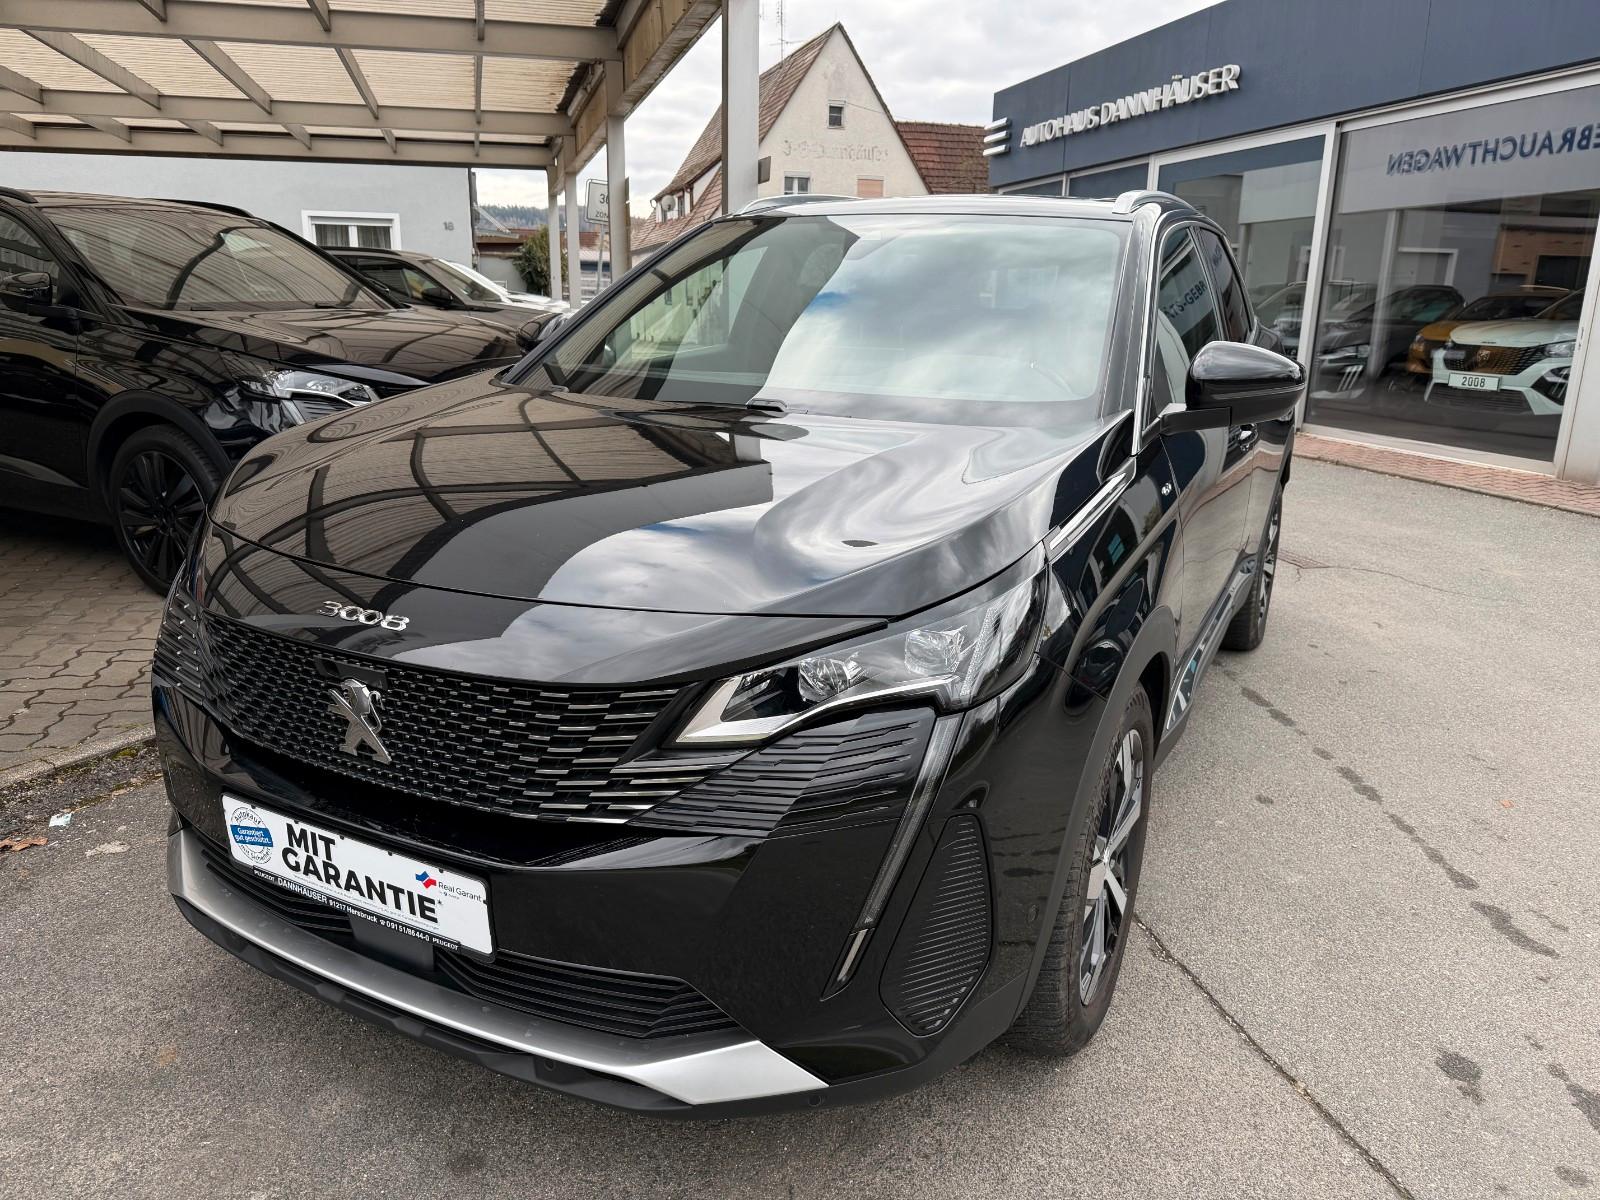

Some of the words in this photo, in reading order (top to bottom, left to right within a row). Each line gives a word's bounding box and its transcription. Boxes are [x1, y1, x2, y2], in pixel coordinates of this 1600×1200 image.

[1020, 107, 1100, 148] AUTOHAUS
[1101, 64, 1241, 126] DANNHÄUSER
[442, 221, 455, 231] 18
[1461, 376, 1486, 388] 2008
[316, 600, 410, 631] 3008
[286, 822, 336, 862] MIT
[438, 881, 455, 893] Real
[456, 887, 482, 902] Garant
[346, 905, 378, 923] Hersbruck
[432, 937, 459, 950] PEUGEOT
